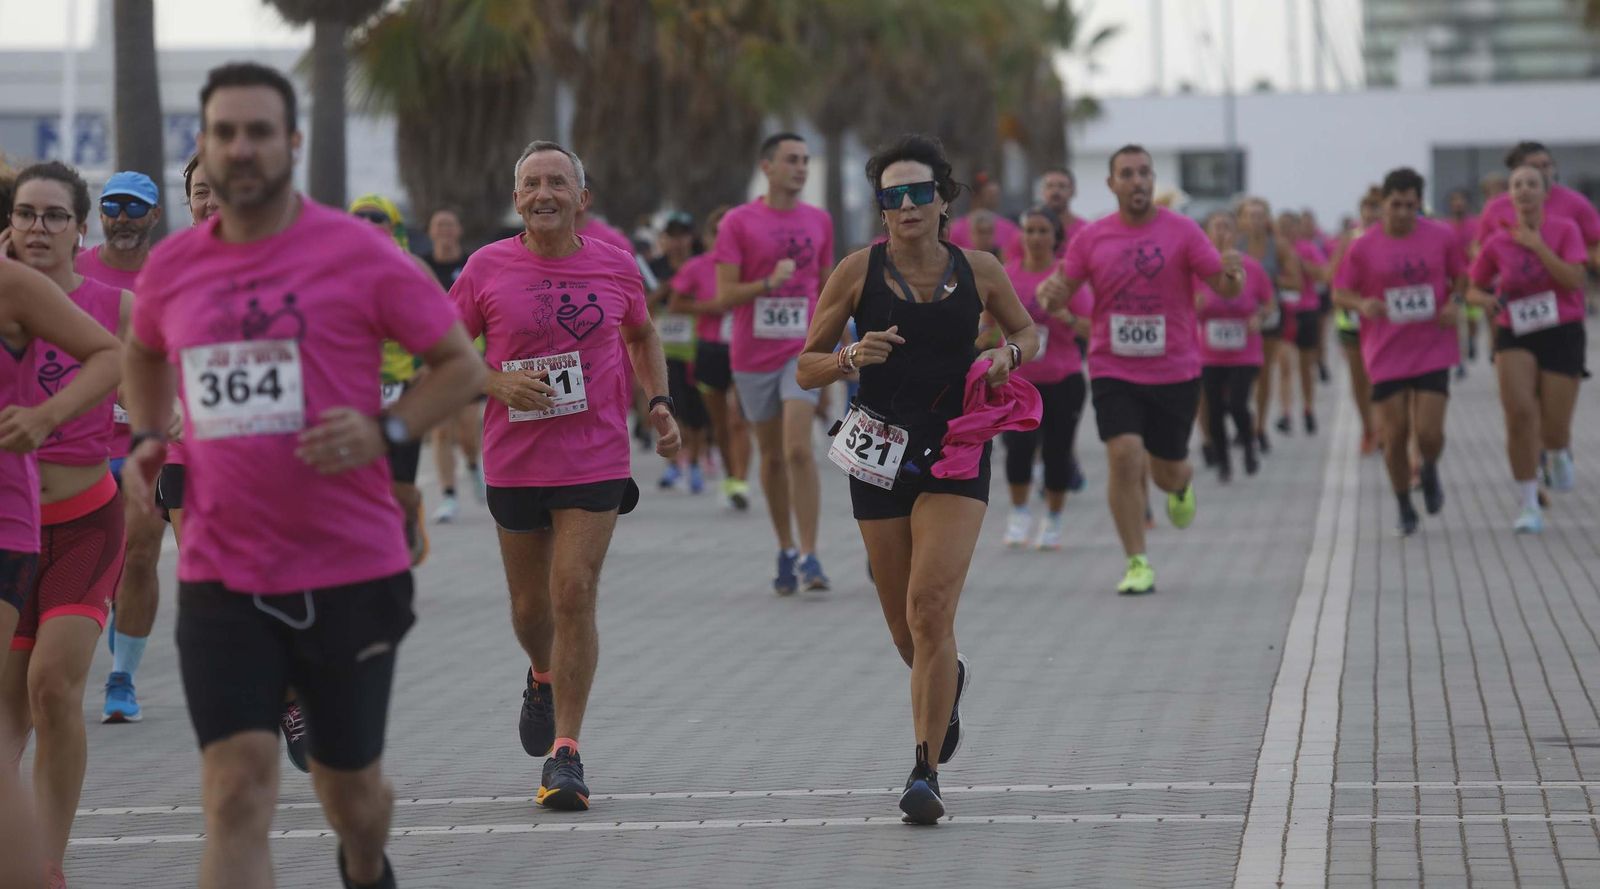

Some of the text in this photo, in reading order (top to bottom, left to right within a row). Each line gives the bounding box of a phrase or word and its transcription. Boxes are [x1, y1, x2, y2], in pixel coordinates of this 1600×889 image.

[763, 307, 801, 327] 361
[1118, 325, 1158, 344] 506
[549, 359, 578, 371] MUJER
[199, 366, 284, 407] 364
[845, 424, 892, 466] 521
